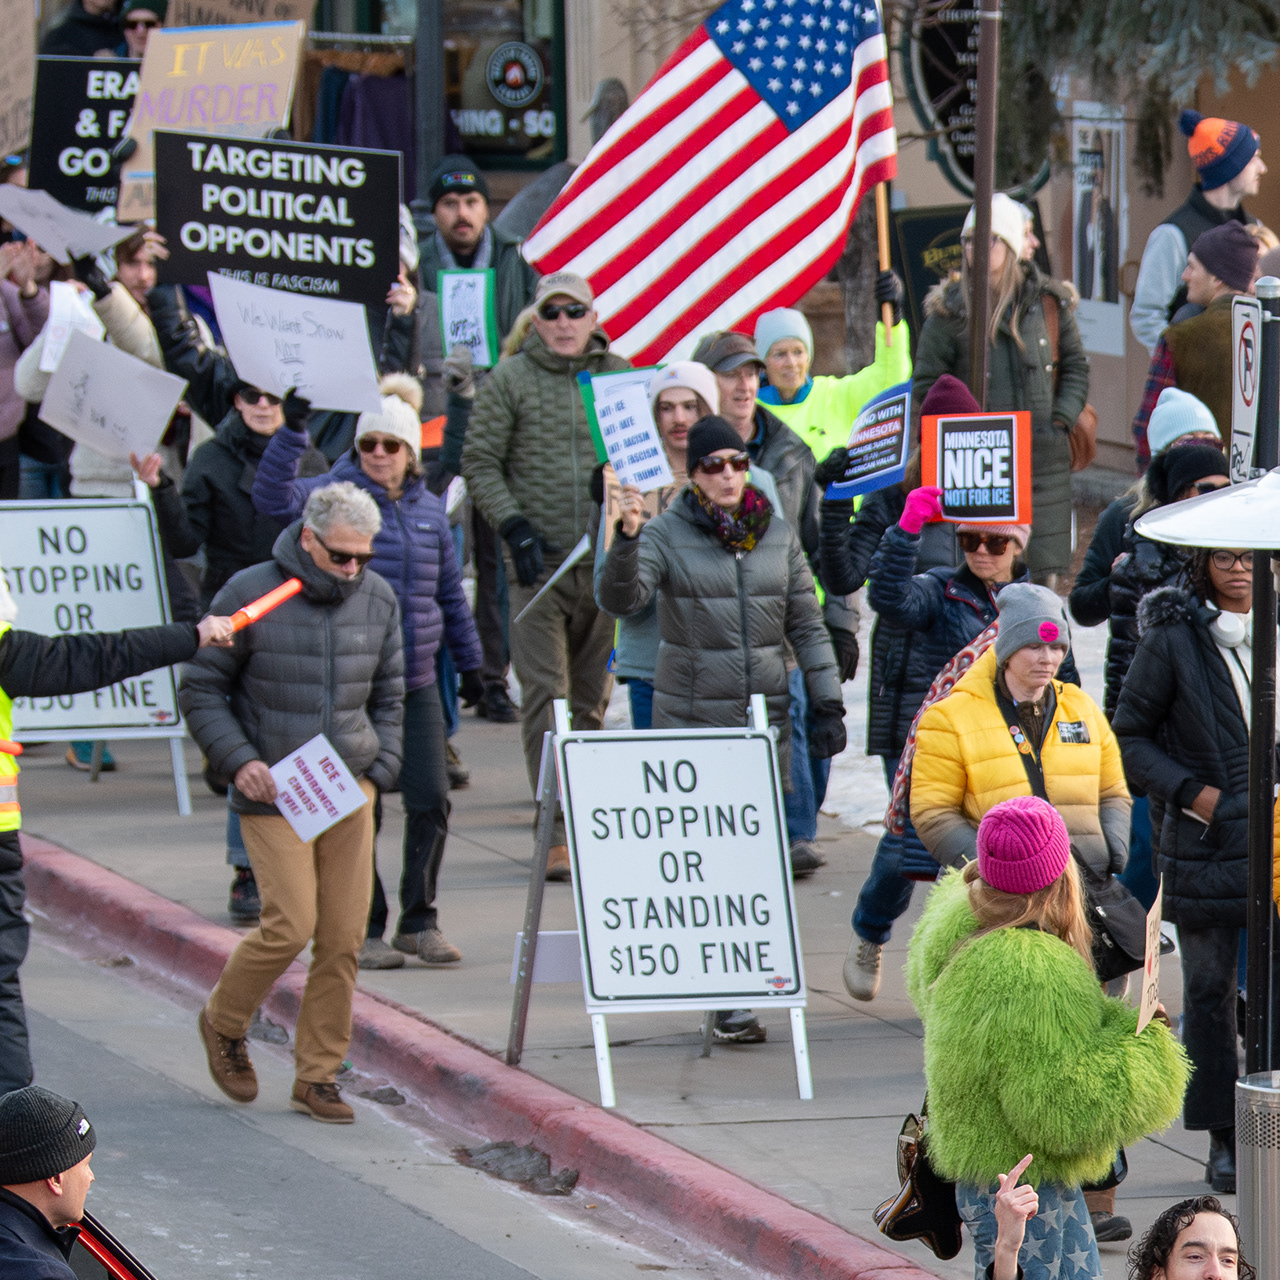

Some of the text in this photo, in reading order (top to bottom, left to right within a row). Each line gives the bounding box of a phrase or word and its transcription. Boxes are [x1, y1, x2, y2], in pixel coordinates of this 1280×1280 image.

[166, 35, 287, 77] IT WAS
[87, 70, 140, 98] ERA
[137, 82, 278, 125] MURDER
[187, 141, 367, 188] TARGETING
[202, 183, 355, 227] POLITICAL
[180, 222, 376, 269] OPPONENTS
[254, 273, 270, 287] IS
[272, 274, 340, 294] FASCISM
[877, 404, 904, 421] WITH
[944, 430, 1009, 449] MINNESOTA
[944, 448, 1010, 488] NICE
[944, 488, 1010, 507] NOT FOR ICE
[38, 525, 87, 555] NO
[54, 604, 95, 631] OR
[318, 756, 340, 782] ICE
[641, 759, 698, 794] NO
[590, 803, 760, 840] STOPPING
[659, 851, 705, 883] OR
[602, 893, 770, 930] STANDING
[609, 940, 774, 977] $150 FINE
